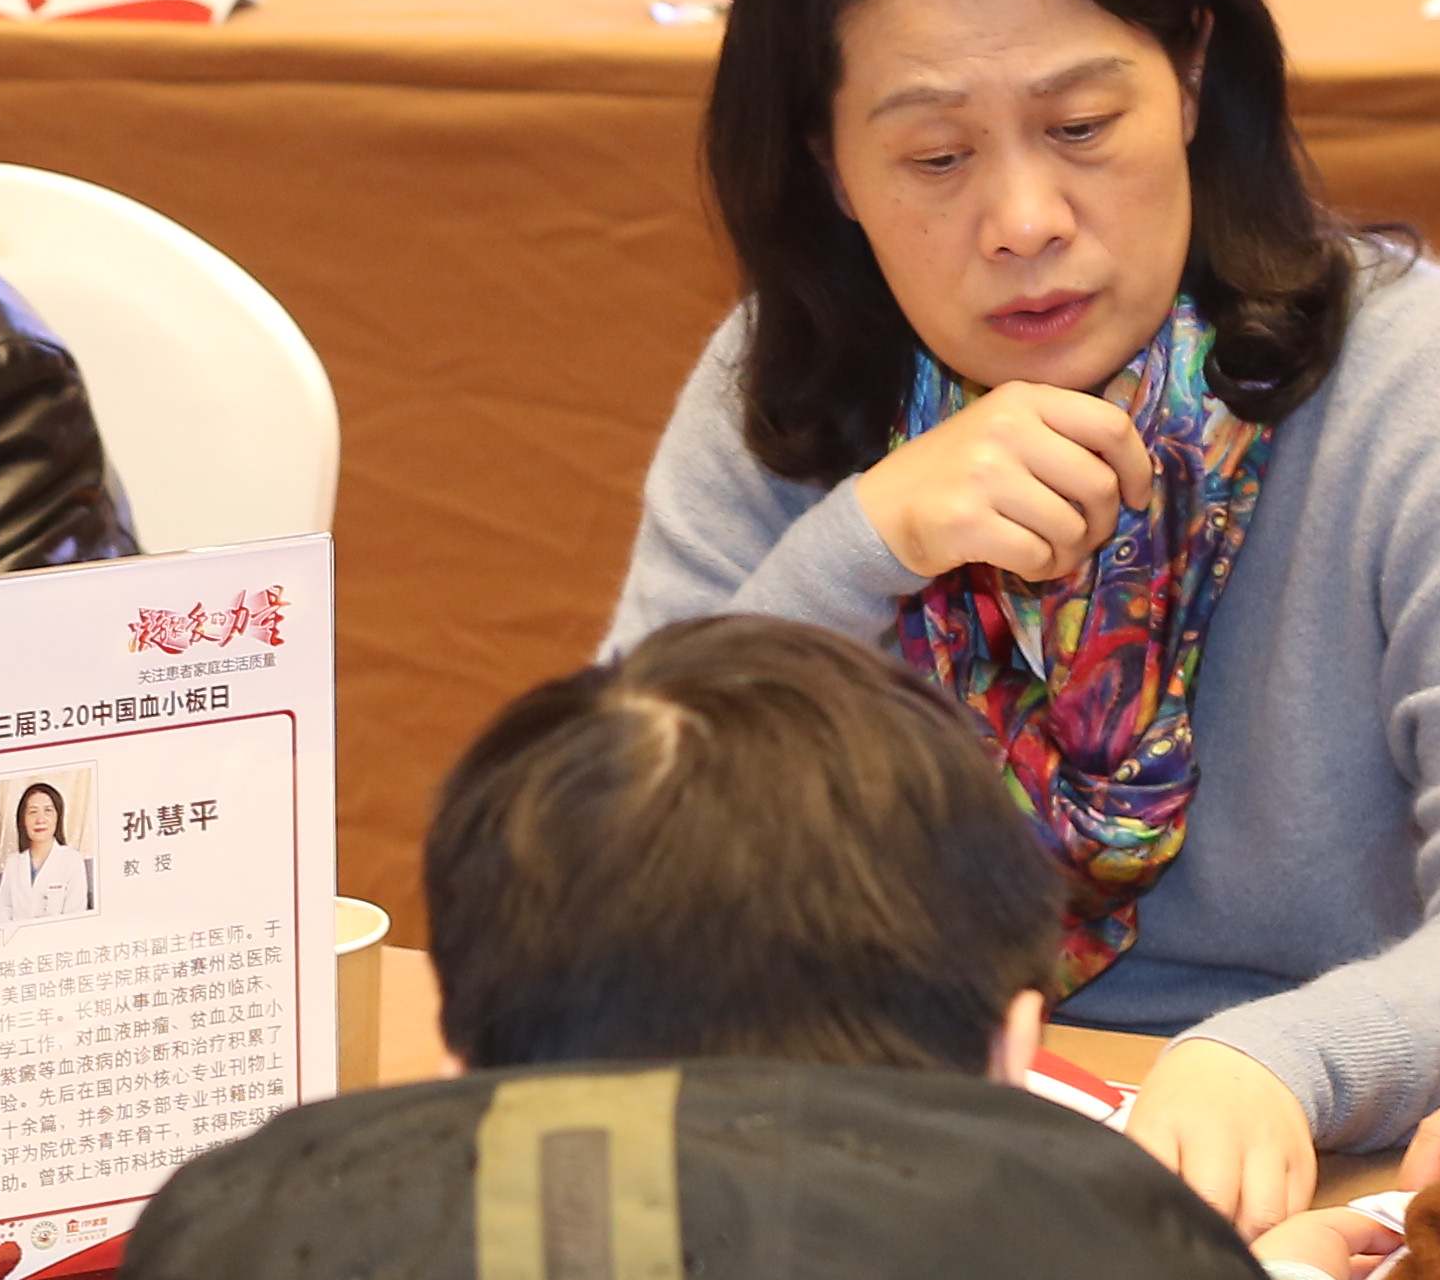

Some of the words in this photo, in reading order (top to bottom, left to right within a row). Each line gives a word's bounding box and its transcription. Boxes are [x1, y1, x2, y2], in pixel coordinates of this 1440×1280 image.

[138, 652, 276, 684] 关注患者家庭生活质量
[123, 799, 219, 843] 孙慧平
[123, 853, 173, 877] 教授
